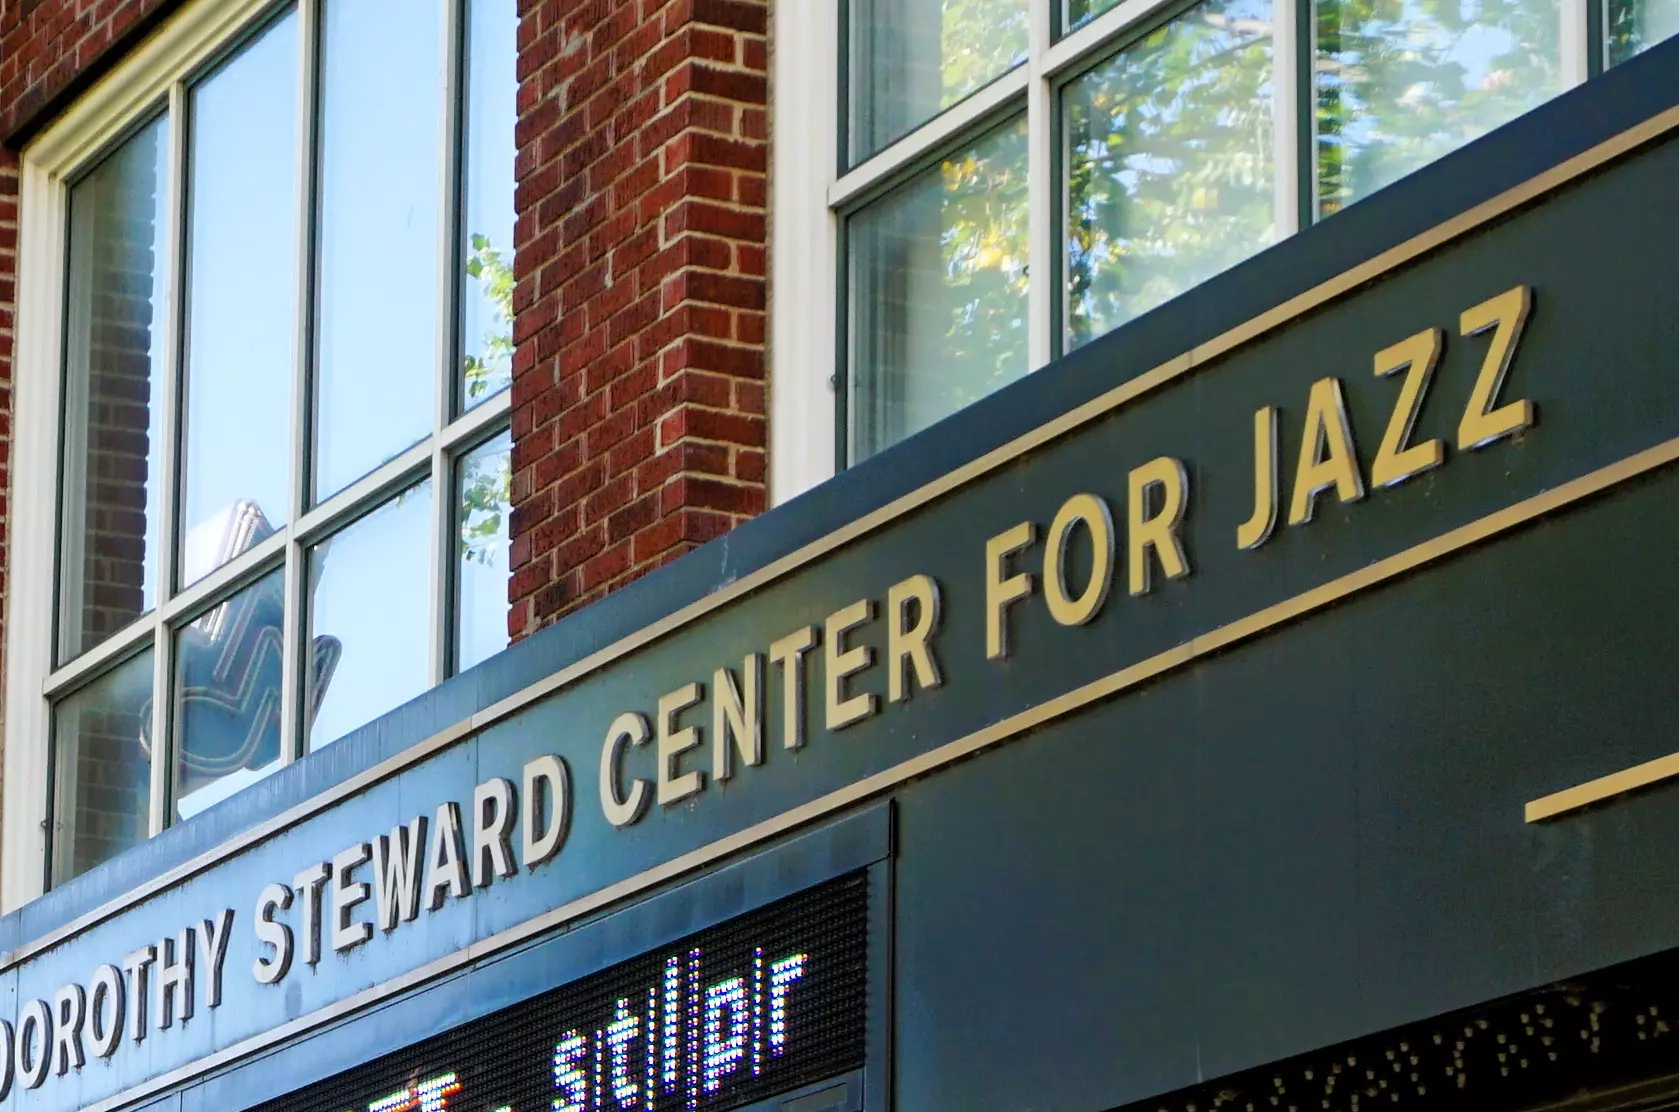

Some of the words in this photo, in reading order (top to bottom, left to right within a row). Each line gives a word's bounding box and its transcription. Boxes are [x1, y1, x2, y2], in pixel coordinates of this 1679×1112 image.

[252, 753, 570, 986] STEWARD
[599, 574, 944, 827] CENTER
[985, 455, 1191, 662] FOR
[1236, 284, 1534, 551] JAZZ
